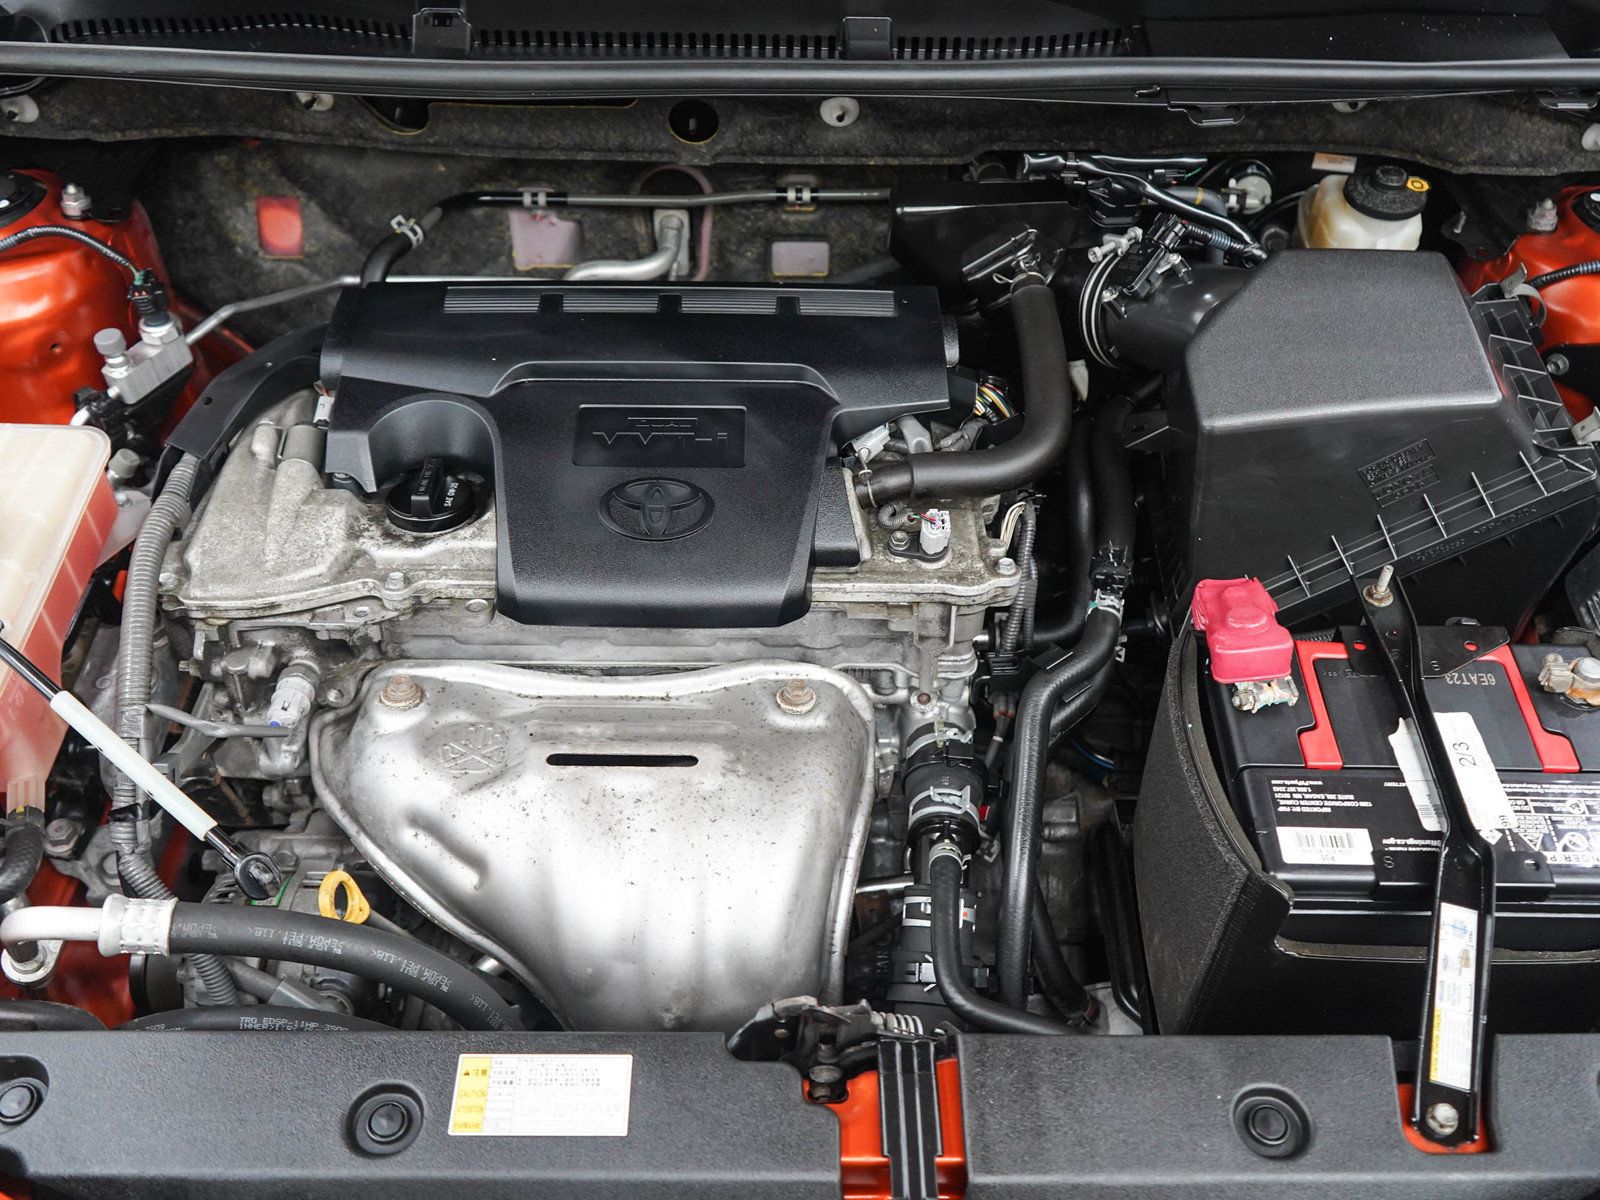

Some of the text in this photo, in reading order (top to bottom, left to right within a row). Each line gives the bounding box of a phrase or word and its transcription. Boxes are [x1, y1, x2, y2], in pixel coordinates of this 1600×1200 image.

[1445, 672, 1496, 686] 6EAT23
[1452, 741, 1478, 767] 2/3
[1383, 855, 1395, 869] S
